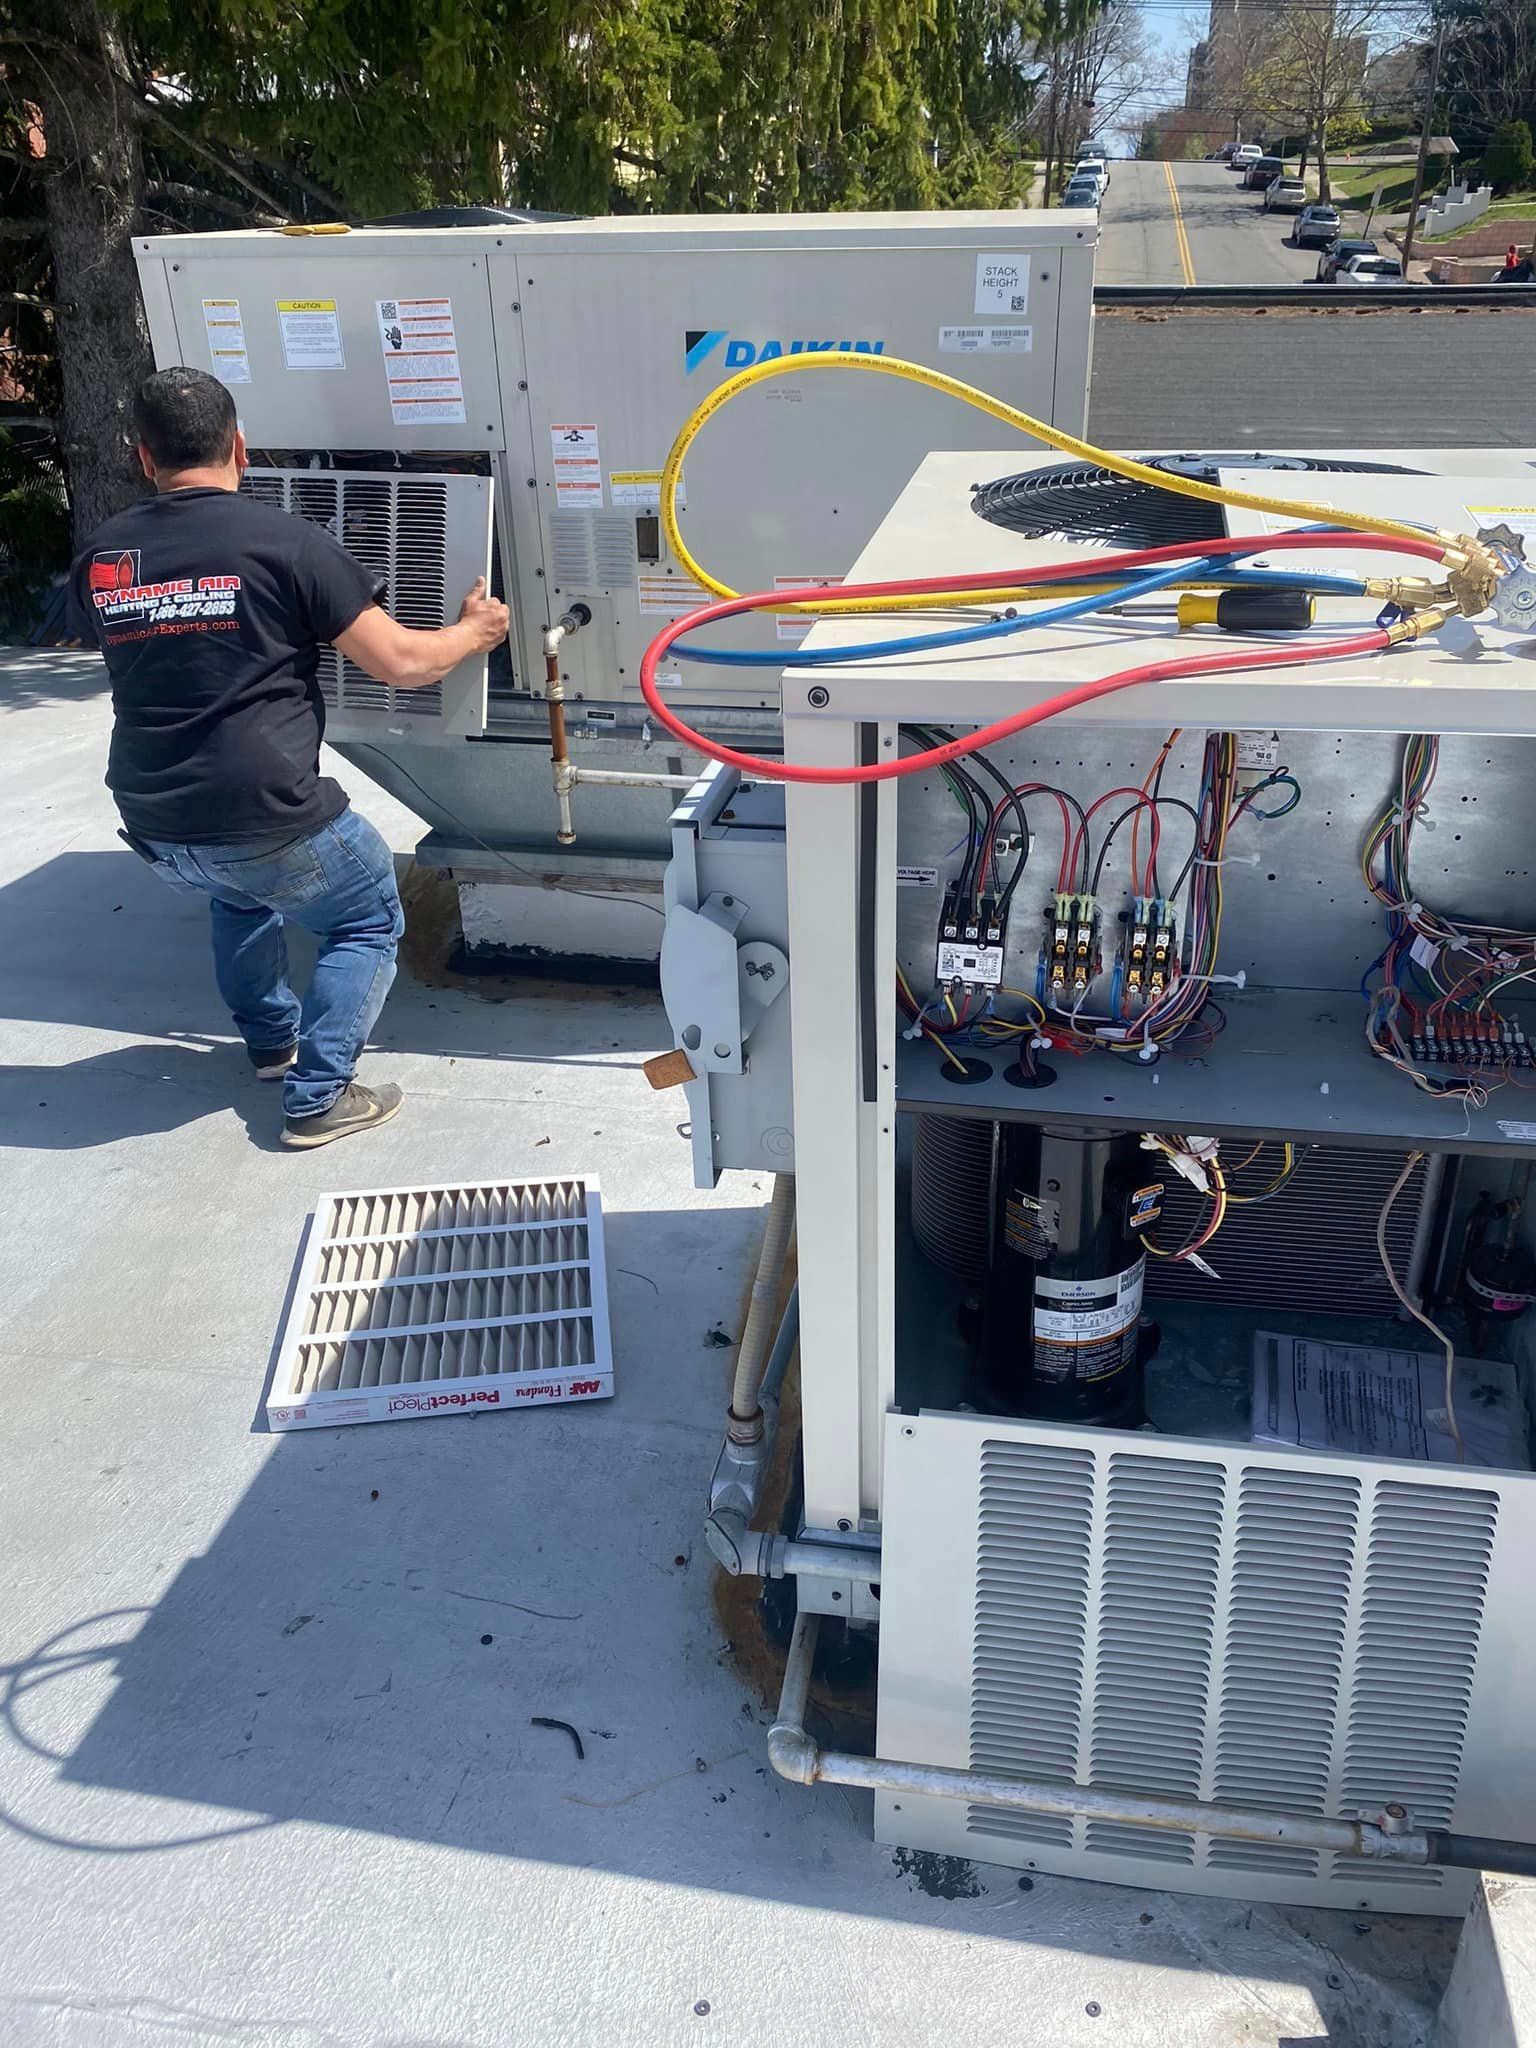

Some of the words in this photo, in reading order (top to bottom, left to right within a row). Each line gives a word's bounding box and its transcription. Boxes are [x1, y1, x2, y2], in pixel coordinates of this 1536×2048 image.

[985, 266, 1017, 276] STACK
[982, 278, 1018, 287] HEIGHT
[997, 289, 1003, 298] 5
[292, 302, 321, 310] CAUTION
[93, 578, 193, 607] DYNAMIC
[198, 576, 241, 591] AIR
[104, 598, 160, 616] HEATING
[161, 594, 173, 605] &
[175, 591, 236, 604] COOLING
[514, 1383, 562, 1399] Flanders
[569, 1380, 601, 1397] AAF
[387, 1389, 501, 1415] PerfectPleat
